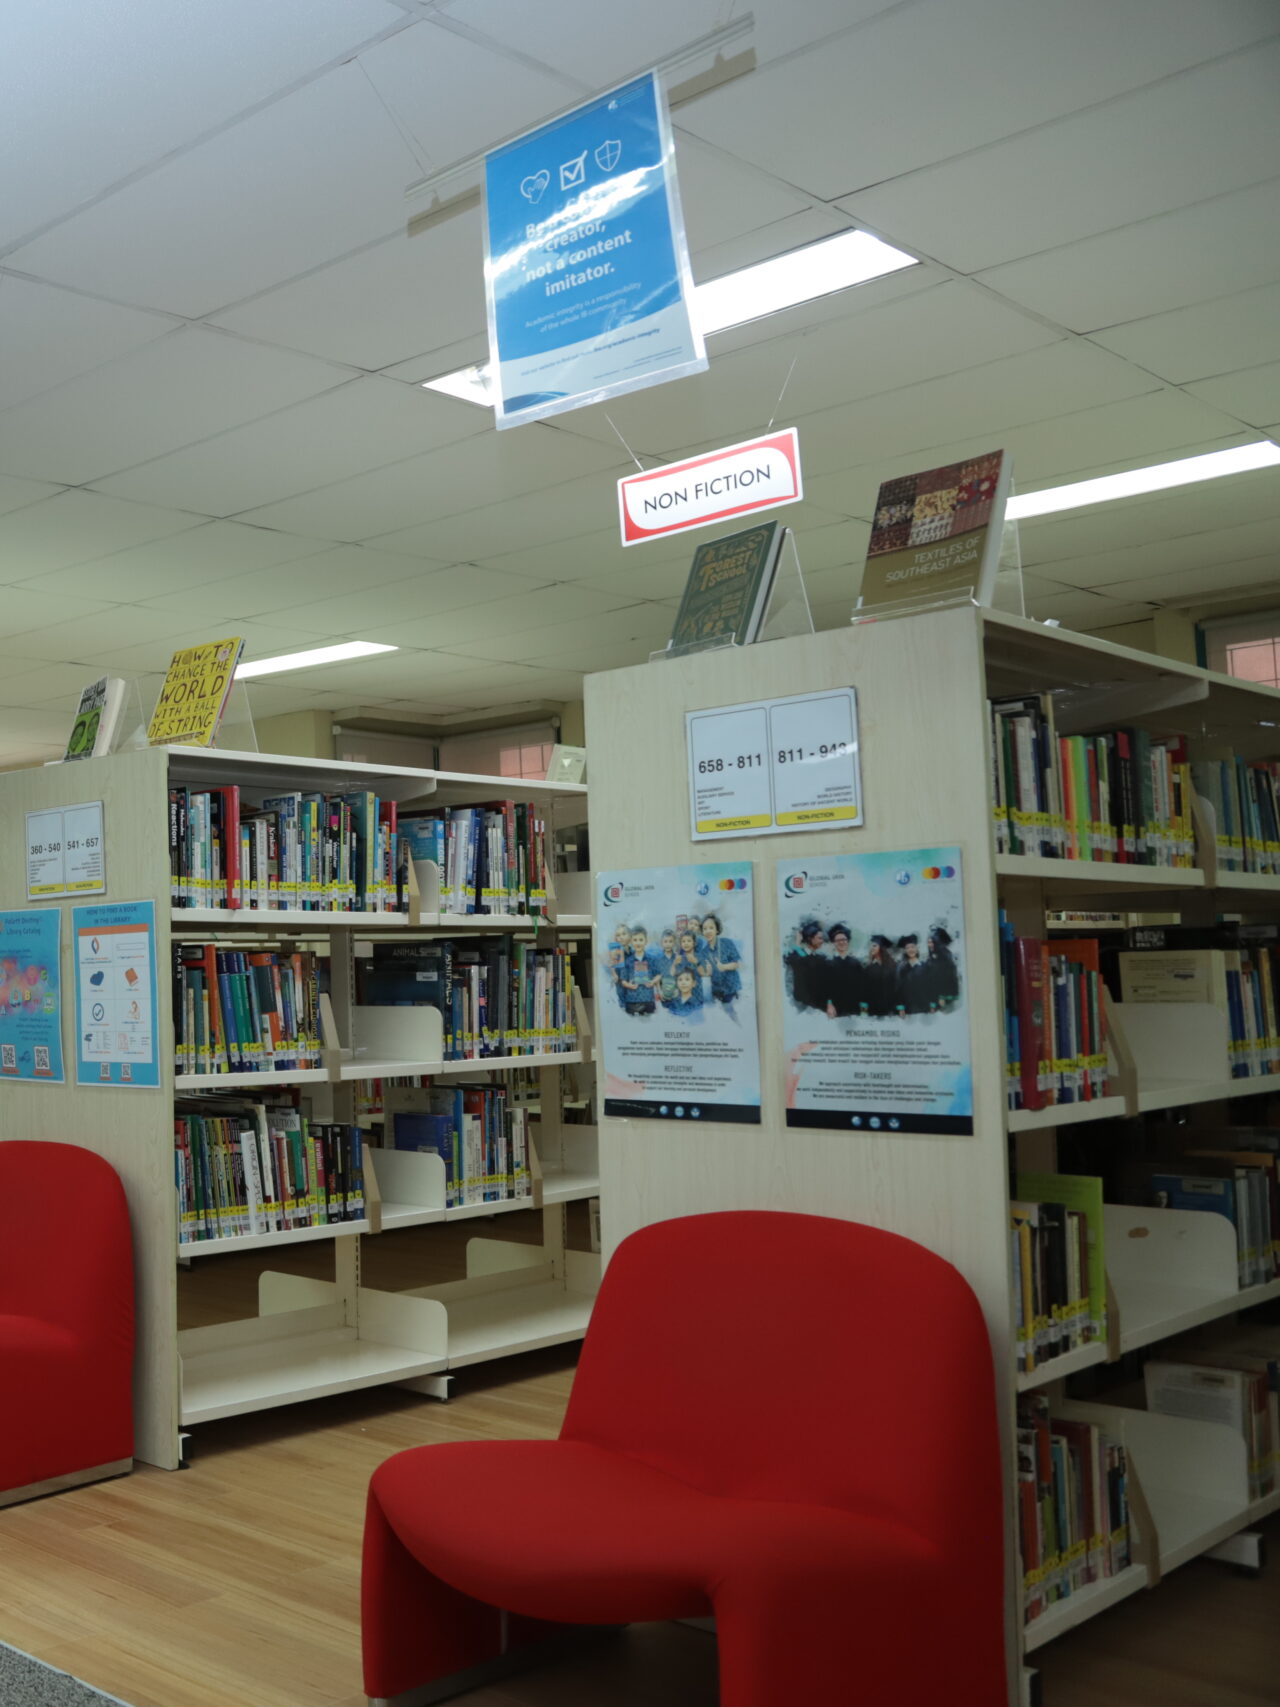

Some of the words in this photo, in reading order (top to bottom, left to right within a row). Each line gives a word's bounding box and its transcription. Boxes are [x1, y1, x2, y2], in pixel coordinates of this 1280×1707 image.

[545, 220, 606, 252] creator,
[526, 261, 553, 281] not
[556, 258, 566, 271] a
[568, 230, 632, 265] content
[545, 262, 615, 297] imitator.
[643, 487, 688, 514] NON
[693, 464, 772, 499] FICTION
[914, 543, 964, 563] TEXTILES
[966, 536, 981, 549] OF
[886, 557, 952, 582] SOUTHEAST
[953, 550, 978, 565] ASIA
[166, 663, 207, 684] CHANGE
[211, 659, 229, 673] THE
[160, 675, 224, 704] WORLD
[154, 707, 182, 719] WITH
[194, 700, 216, 712] BALL
[149, 721, 163, 738] OF
[165, 712, 214, 736] STRING
[698, 758, 724, 774] 658
[737, 753, 763, 769] 811
[778, 748, 804, 764] 811
[716, 819, 751, 828] NON-FICTION
[797, 811, 835, 821] NON-FICTION
[31, 844, 43, 855] 360
[48, 842, 61, 853] 540
[67, 840, 79, 850] 541
[86, 837, 99, 848] 657
